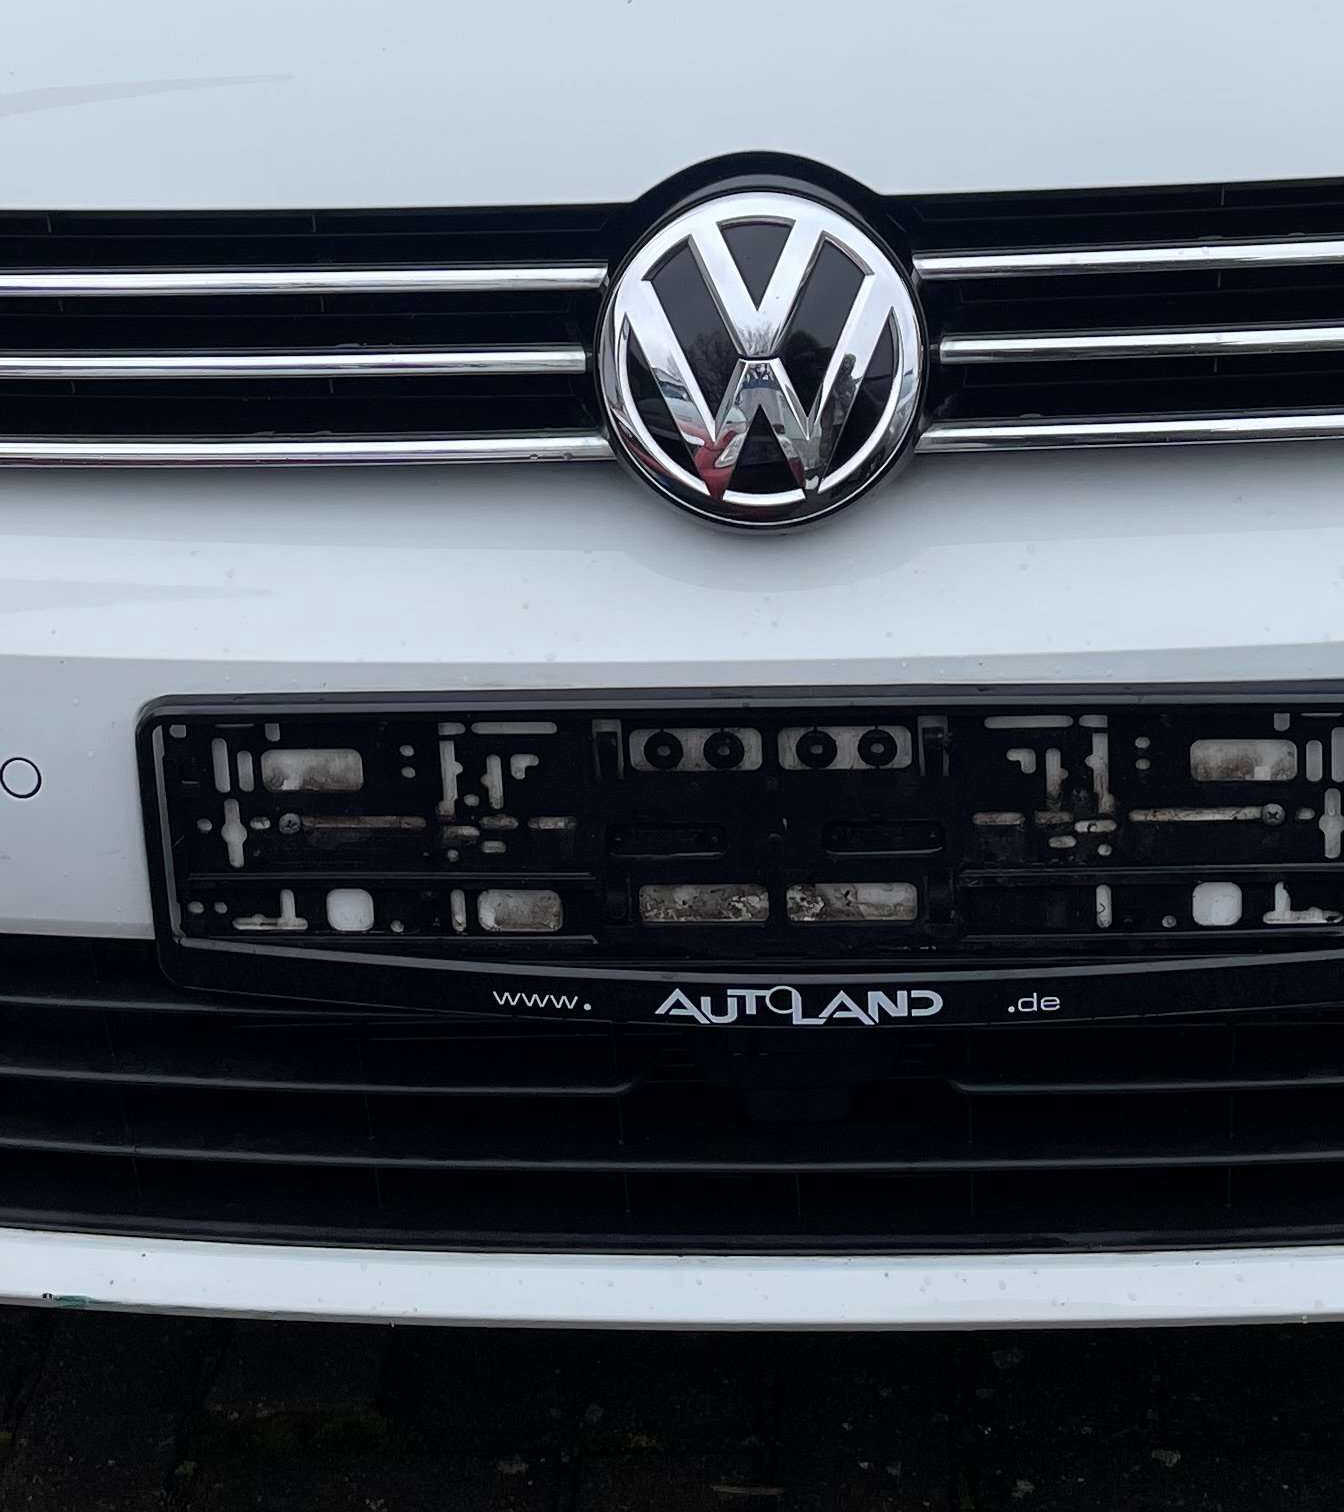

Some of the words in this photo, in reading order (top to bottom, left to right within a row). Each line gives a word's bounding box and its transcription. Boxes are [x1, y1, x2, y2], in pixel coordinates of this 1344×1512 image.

[608, 198, 914, 510] VW
[492, 990, 593, 1011] www.
[653, 985, 945, 1026] AUTOLAND
[1007, 991, 1061, 1014] .de
